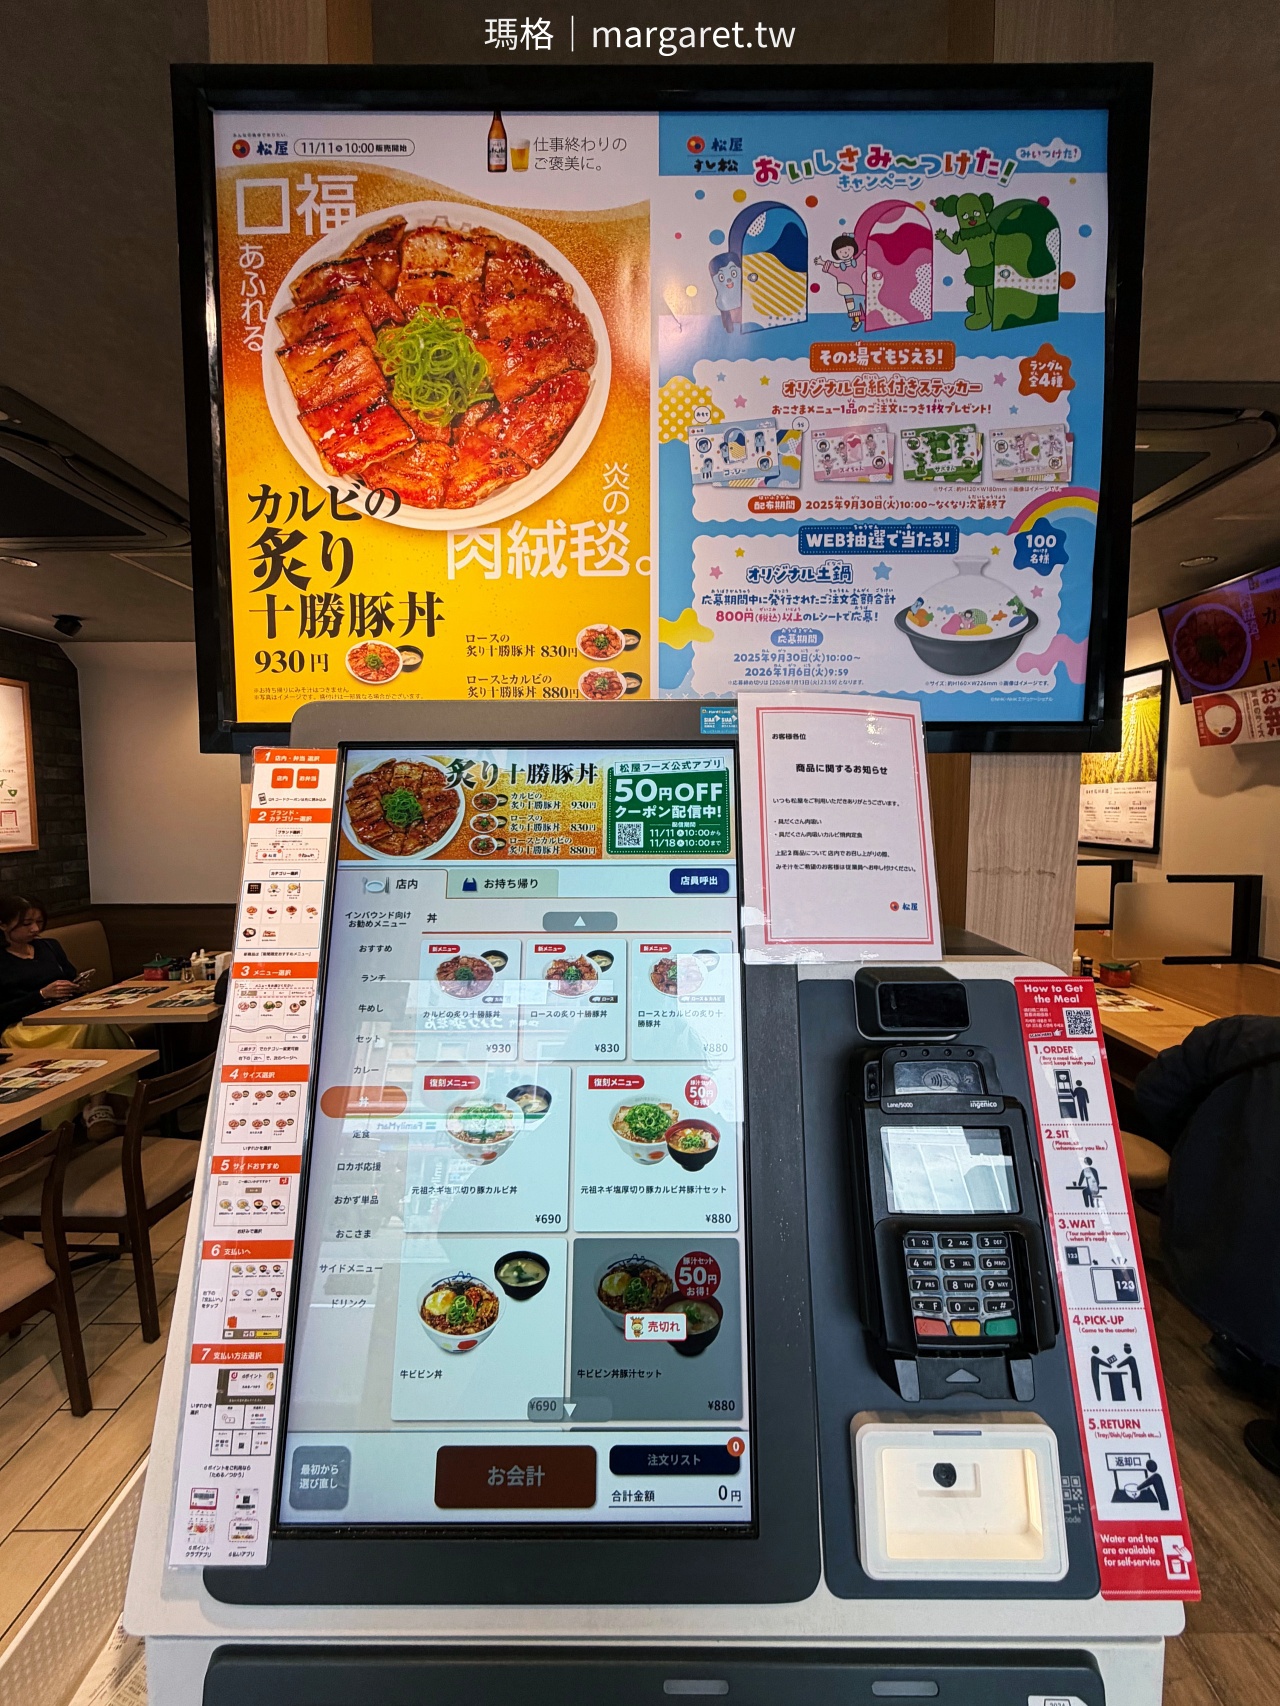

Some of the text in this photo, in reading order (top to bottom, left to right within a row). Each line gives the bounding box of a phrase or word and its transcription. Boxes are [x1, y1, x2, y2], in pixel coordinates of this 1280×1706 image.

[256, 140, 289, 156] 松屋
[533, 136, 627, 152] 仕事終わりの
[711, 137, 743, 152] 松屋
[534, 155, 602, 172] ご褒美に。
[838, 174, 922, 190] キャンペーン
[235, 174, 358, 236] 口福
[237, 242, 267, 352] あふれる
[1029, 360, 1064, 371] ランダム
[1028, 373, 1064, 388] 全4種
[783, 377, 983, 398] オリジナル台紙付きステッカー
[602, 461, 630, 515] 炎の
[247, 483, 402, 524] カルビの
[753, 500, 796, 510] 配布期間
[1026, 534, 1057, 548] 100
[446, 518, 651, 580] 肉絨毯。
[247, 526, 355, 594] 炙り
[1030, 551, 1050, 564] 名様
[747, 565, 853, 583] オリジナル土鍋
[701, 594, 896, 606] 応募期間中に発行されたご注文金額合計
[248, 591, 446, 640] 十勝豚丼
[465, 633, 510, 643] ロースの
[777, 633, 818, 644] 応募期間
[465, 645, 578, 658] 炙り十勝豚丼 830円
[254, 649, 329, 674] 930円
[466, 674, 553, 685] ロースとカルビの
[467, 686, 579, 699] 炙り十勝豚丼 880円
[264, 751, 272, 762] 1
[619, 759, 721, 773] 松屋フーズ公式アプリ
[795, 763, 888, 775] 商品に関するお知らせ
[445, 758, 599, 790] 炙り十勝豚丼
[510, 792, 542, 800] カルビの
[614, 778, 723, 803] 50円OFF
[510, 801, 597, 810] 炙り十勝豚丼 930円
[772, 797, 900, 807] いつも松屋をご利用いただきありがとうございます。
[257, 811, 267, 821] 2
[510, 814, 542, 822] ロースの
[510, 823, 596, 832] 炙り十勝豚丼 830円
[509, 837, 572, 845] ロースとカルビの
[509, 845, 596, 855] 炙り十勝豚丼 880円
[395, 878, 418, 890] 店内
[484, 878, 539, 890] お持ち帰り
[680, 875, 718, 886] 店員呼出
[902, 902, 919, 911] 松屋
[344, 911, 412, 920] インバウンド向け
[426, 913, 438, 924] 丼
[348, 919, 407, 928] お勧めメニュー
[358, 945, 393, 953] おすすめ
[240, 965, 250, 976] 3
[361, 974, 386, 982] ランチ
[1023, 984, 1084, 993] How to Get
[1034, 994, 1080, 1004] the Meal
[358, 1004, 384, 1013] 牛めし
[530, 1010, 608, 1018] ロースの炙り十勝豚丼
[637, 1010, 724, 1018] ロースとカルビの炙り十
[423, 1010, 500, 1019] カルビの炙り十勝豚丼
[637, 1019, 661, 1028] 勝豚丼
[356, 1035, 381, 1044] セット
[486, 1043, 512, 1053] ¥930
[594, 1043, 620, 1053] ¥830
[703, 1043, 728, 1053] ¥880
[1033, 1045, 1074, 1055] 1.ORDER
[229, 1068, 276, 1080] 4 サイズ選択
[353, 1066, 379, 1075] カレー
[429, 1078, 476, 1088] 復刻メニュー
[593, 1078, 640, 1087] 復刻メニュー
[689, 1086, 714, 1098] 50円
[358, 1096, 370, 1107] 丼
[969, 1101, 998, 1109] ingenico
[352, 1130, 370, 1139] 定食
[1044, 1129, 1070, 1139] 2.SIT
[220, 1159, 280, 1171] 5 サイドおすすめ
[337, 1162, 382, 1171] ロカボ応援
[580, 1185, 727, 1194] 元祖ネギ塩厚切り豚カルビ丼豚汁セット
[334, 1195, 379, 1205] おかず単品
[535, 1213, 562, 1224] ¥690
[705, 1213, 732, 1223] ¥880
[1058, 1219, 1096, 1229] 3.WAIT
[335, 1229, 372, 1239] おこさま
[211, 1244, 221, 1256] 6
[682, 1256, 715, 1265] 豚汁セット
[319, 1264, 383, 1273] サイドメニュー
[678, 1266, 718, 1286] 50円
[1116, 1280, 1136, 1290] 123
[331, 1298, 367, 1309] ドリンク
[1072, 1315, 1124, 1326] 4.PICK-UP
[647, 1321, 681, 1333] 売切れ
[201, 1347, 263, 1361] 7 支払い方法選択
[399, 1369, 443, 1380] 牛ビビン丼
[577, 1369, 662, 1379] 牛ビビン丼豚汁セット
[529, 1400, 557, 1412] ¥690
[707, 1400, 736, 1411] ¥880
[1088, 1418, 1141, 1430] 5.RETURN
[732, 1441, 740, 1452] 0
[647, 1453, 701, 1466] 注文リスト
[1114, 1456, 1142, 1467] 返却口
[300, 1464, 339, 1476] 最初から
[487, 1465, 546, 1487] お会計
[299, 1477, 338, 1489] 選び直し
[611, 1489, 655, 1502] 合計金額
[717, 1485, 742, 1502] 0 円
[1100, 1534, 1159, 1543] Water and tea
[1102, 1545, 1155, 1555] are available
[1104, 1557, 1161, 1567] for self-service
